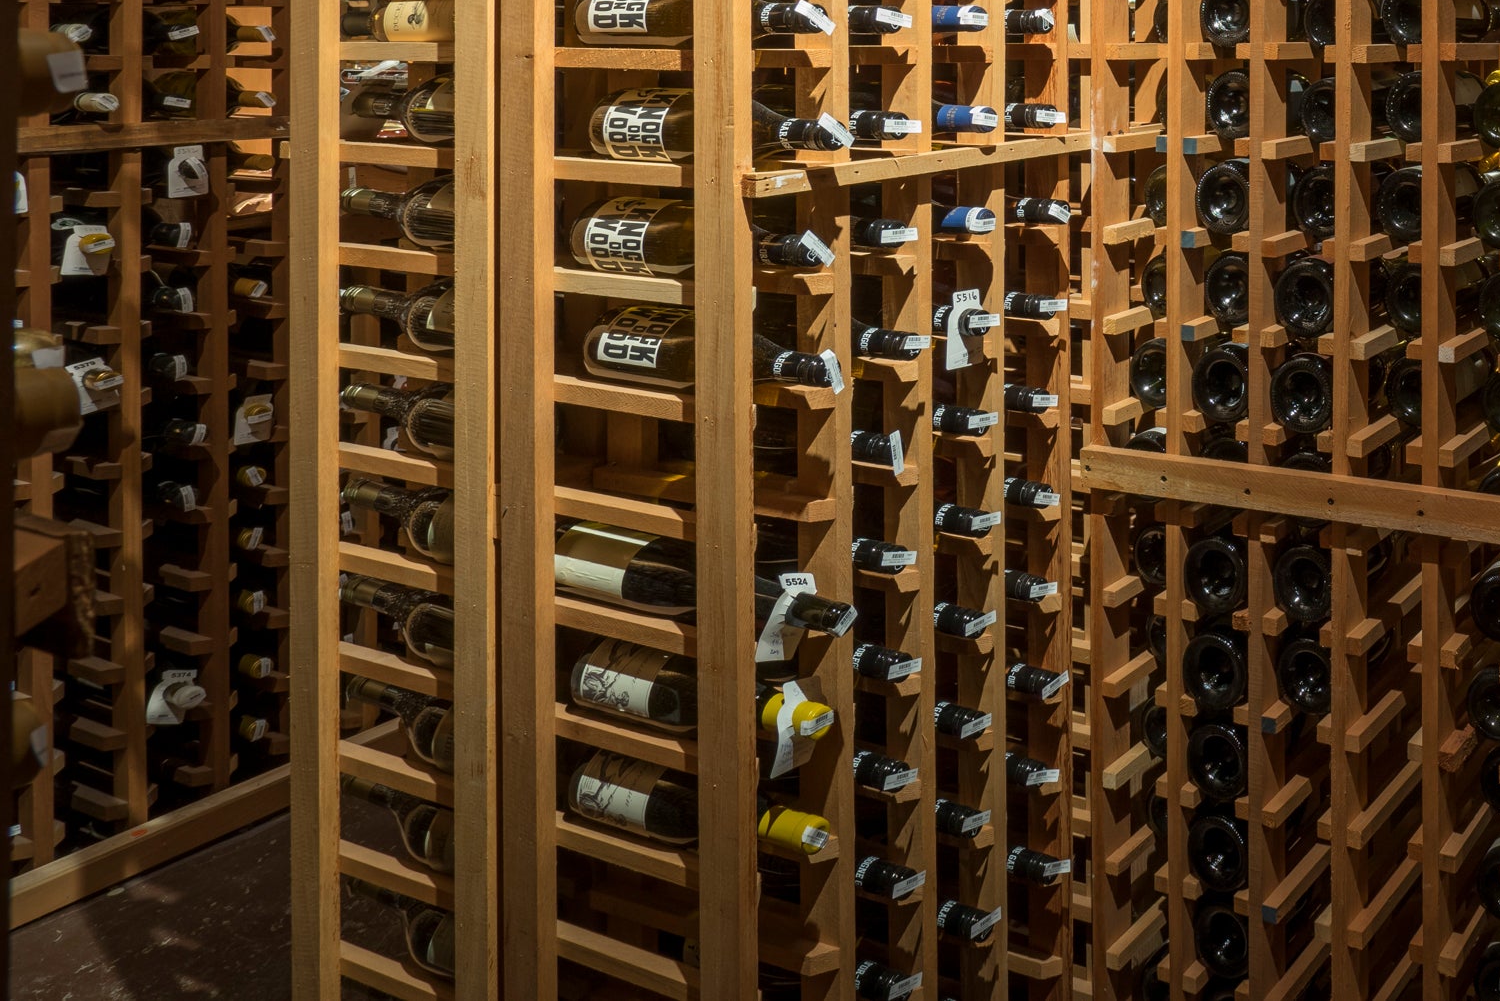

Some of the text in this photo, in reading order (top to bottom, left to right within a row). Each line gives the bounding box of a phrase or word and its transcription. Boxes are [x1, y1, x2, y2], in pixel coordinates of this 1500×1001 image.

[608, 100, 642, 157] WOOD
[627, 125, 641, 142] ON
[637, 94, 679, 159] KNOCK
[589, 214, 622, 271] WOOD
[609, 241, 623, 259] ON
[616, 207, 659, 276] KNOCK
[956, 290, 978, 303] 5516
[785, 577, 808, 587] 5524
